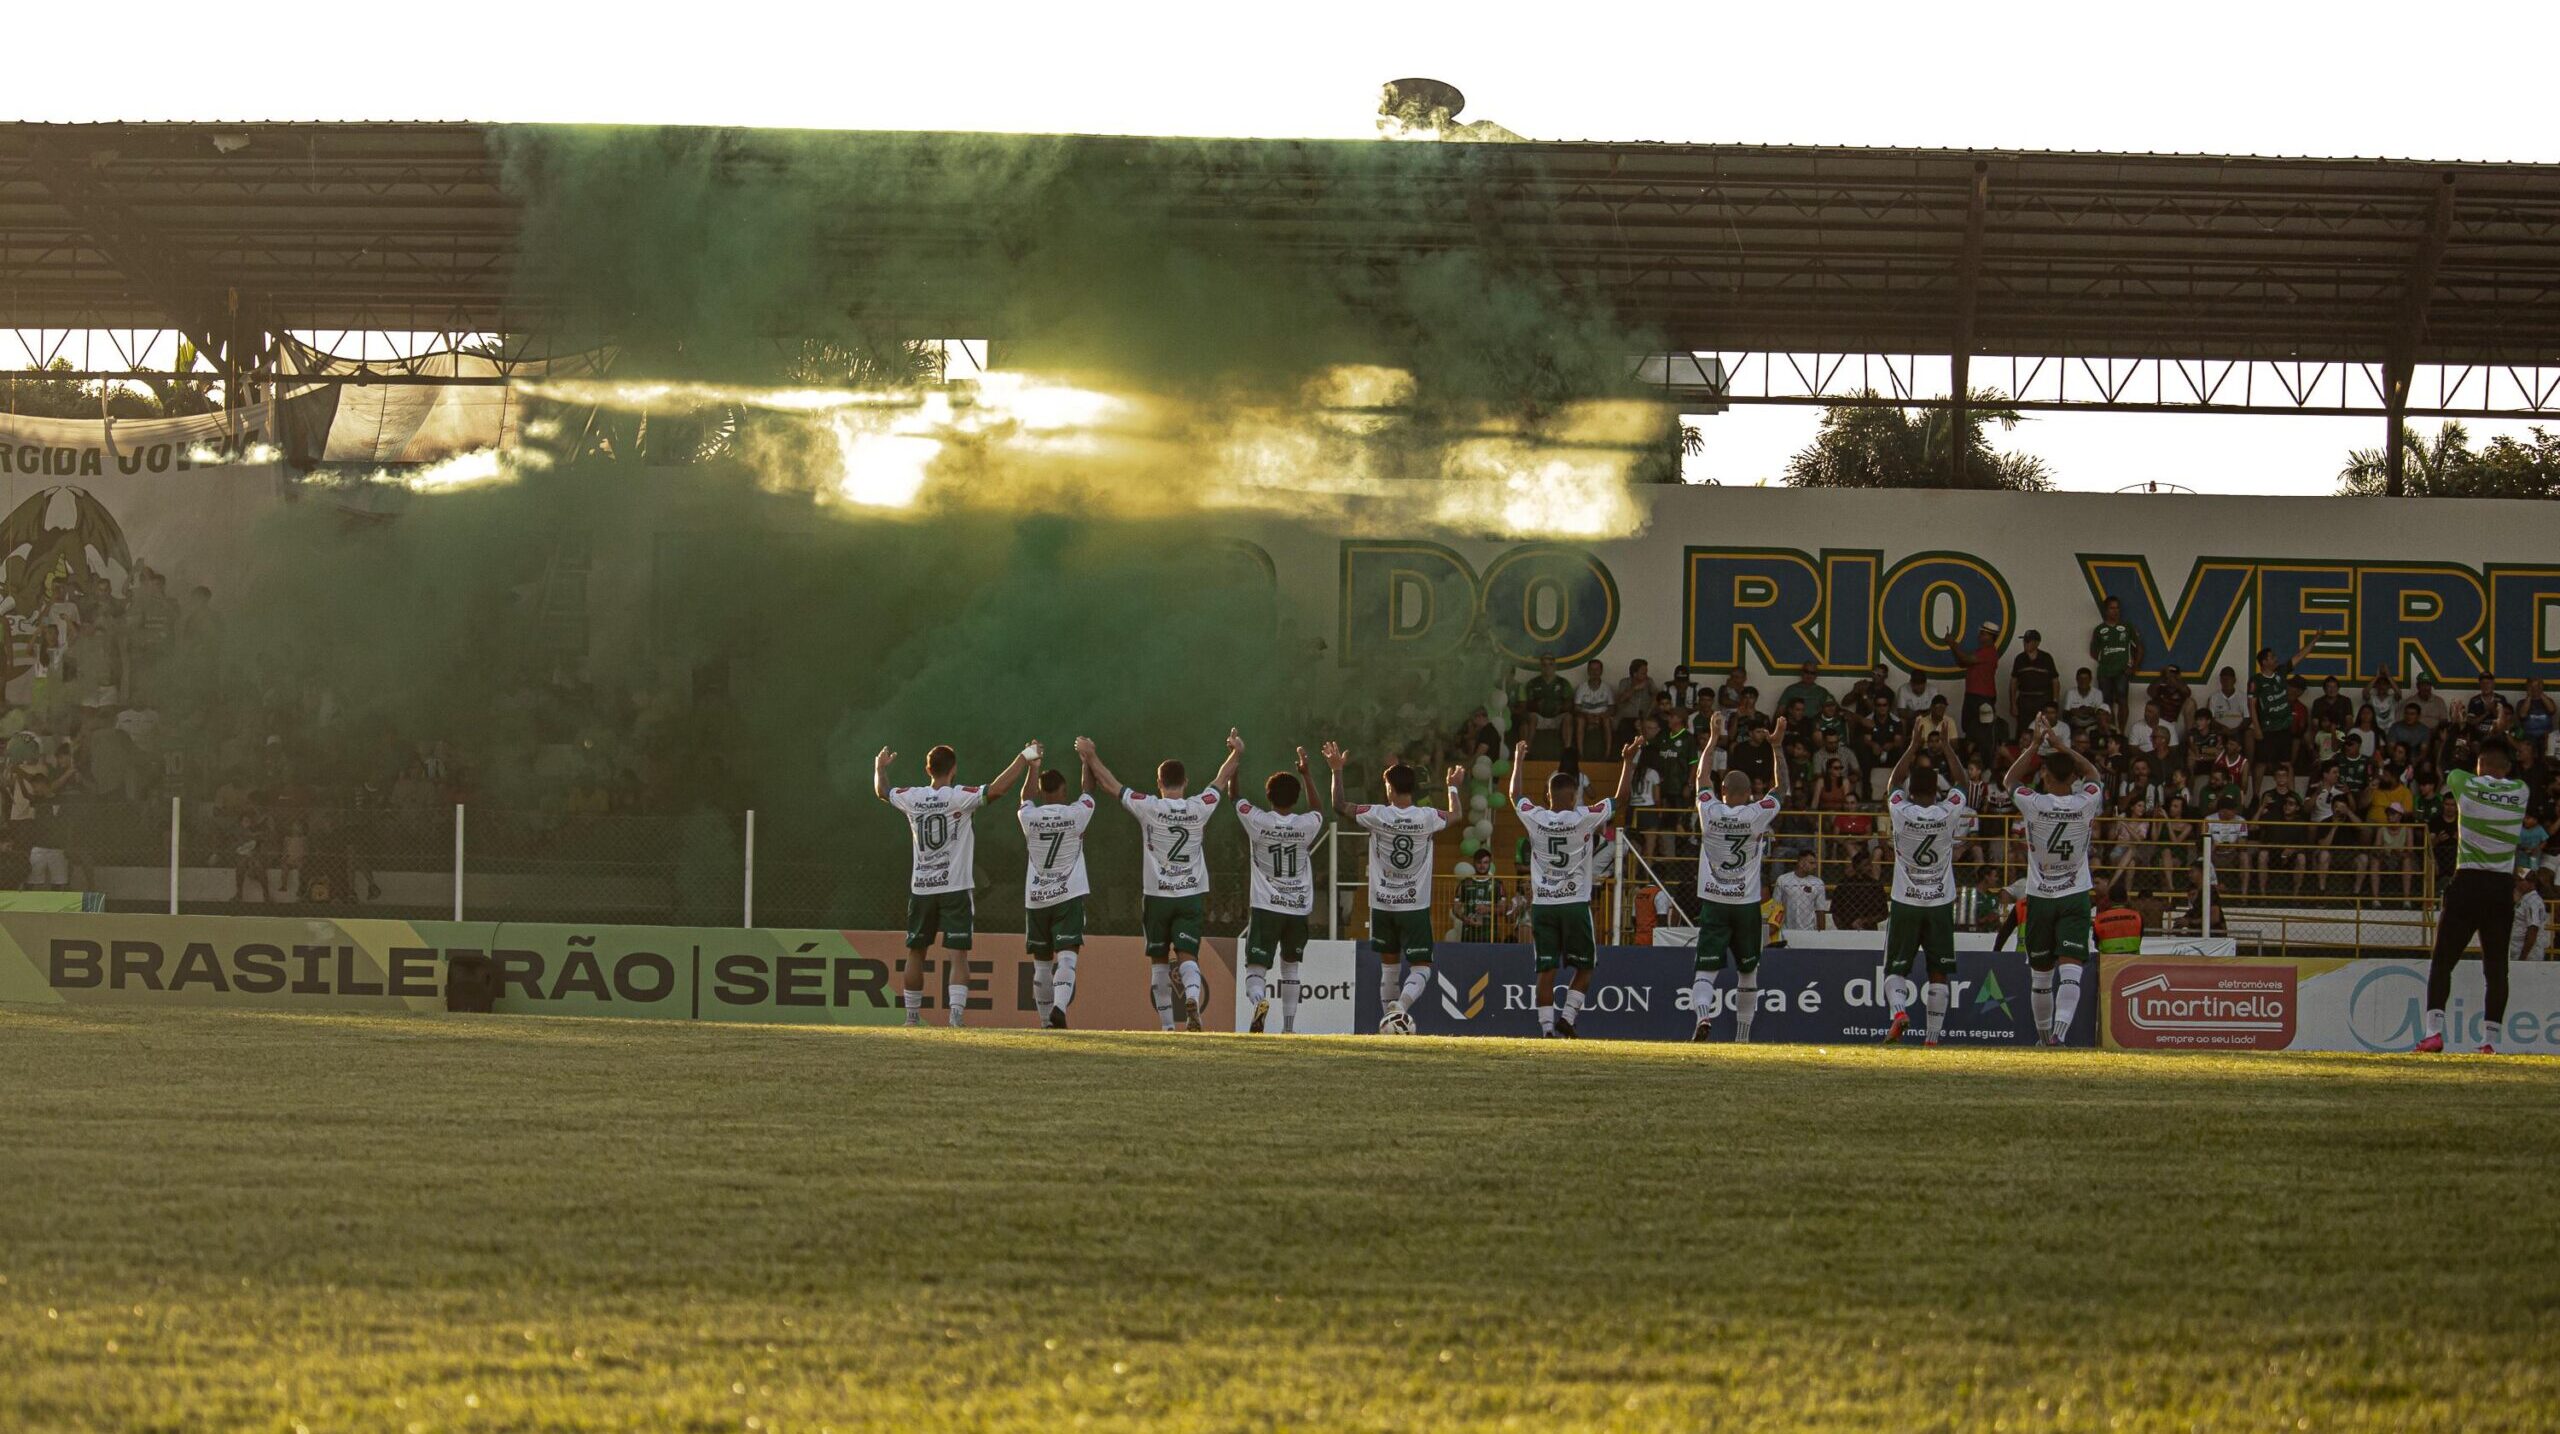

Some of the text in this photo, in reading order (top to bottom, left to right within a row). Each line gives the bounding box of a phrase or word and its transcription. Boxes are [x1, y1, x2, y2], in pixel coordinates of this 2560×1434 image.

[1338, 539, 1621, 672] DO
[1684, 545, 2017, 682] RIO
[915, 813, 948, 852] 10
[1260, 829, 1306, 839] PACAEMBU
[1708, 820, 1751, 829] PACAEMBU
[2047, 821, 2074, 861] 4
[1039, 831, 1065, 869] 7
[1167, 825, 1190, 863] 2
[1268, 843, 1297, 878] 11
[1390, 834, 1415, 869] 8
[1548, 836, 1570, 868] 5
[1720, 834, 1751, 870] 3
[1912, 834, 1938, 867] 6
[1797, 981, 1822, 1013] é
[2218, 980, 2283, 990] eletromóveis
[2147, 995, 2283, 1018] martinello
[1843, 1026, 1868, 1036] alta
[1949, 1030, 1967, 1038] em
[1969, 1030, 2015, 1040] seguros
[2156, 1035, 2256, 1045] sempre ao seu lado!
